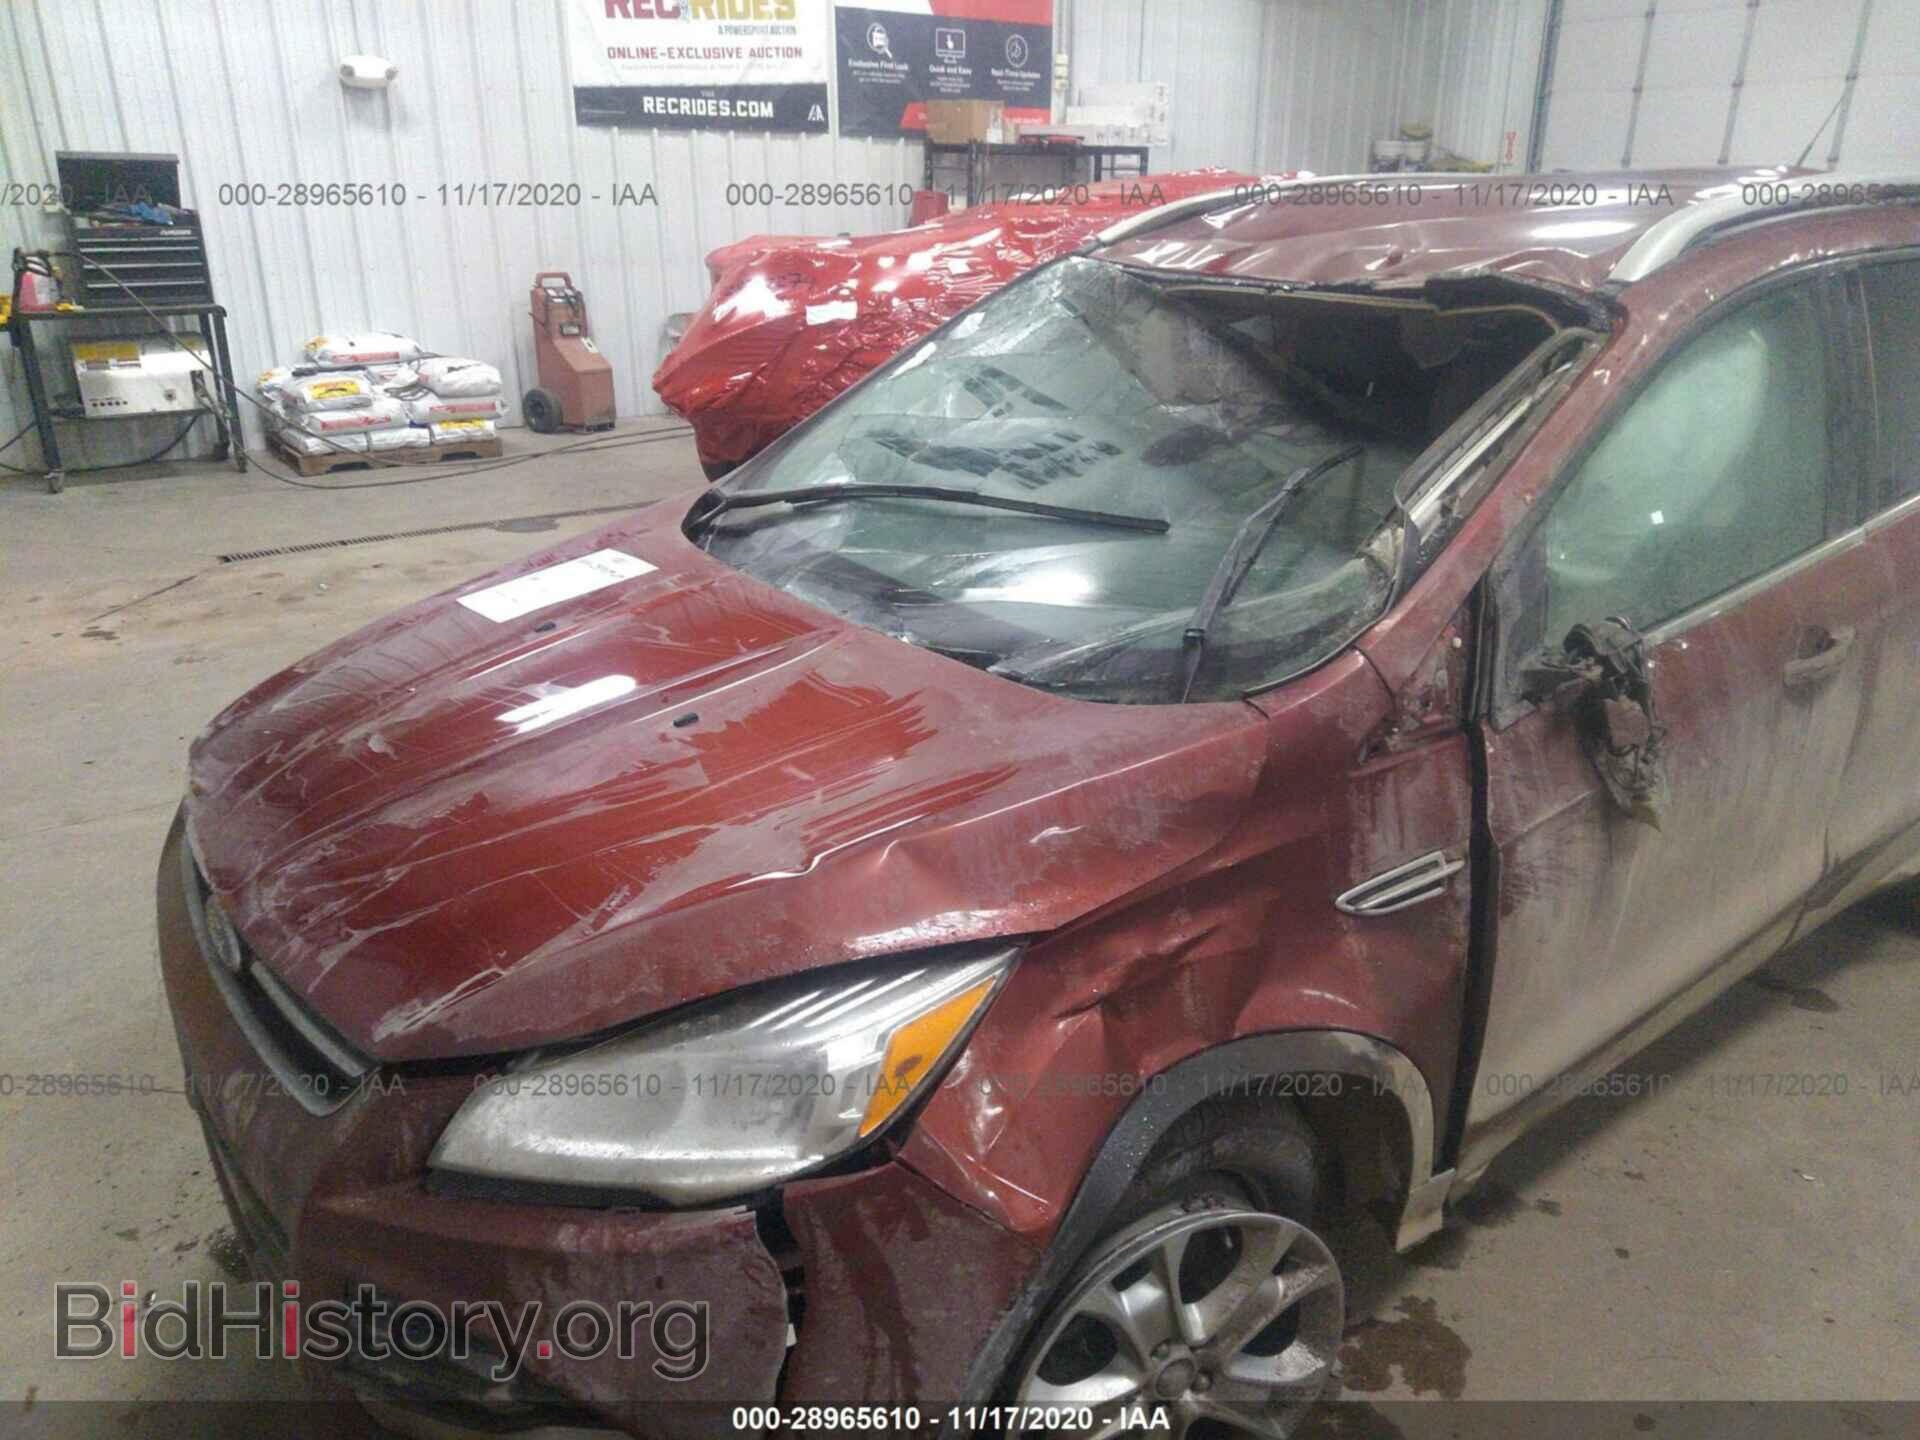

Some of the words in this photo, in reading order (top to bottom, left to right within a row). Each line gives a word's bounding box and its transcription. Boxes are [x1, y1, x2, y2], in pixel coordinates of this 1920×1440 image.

[607, 46, 743, 60] ONLINE-EXCLUSIVE
[748, 46, 803, 59] AUCTION
[642, 95, 774, 118] RECRIDES.COM
